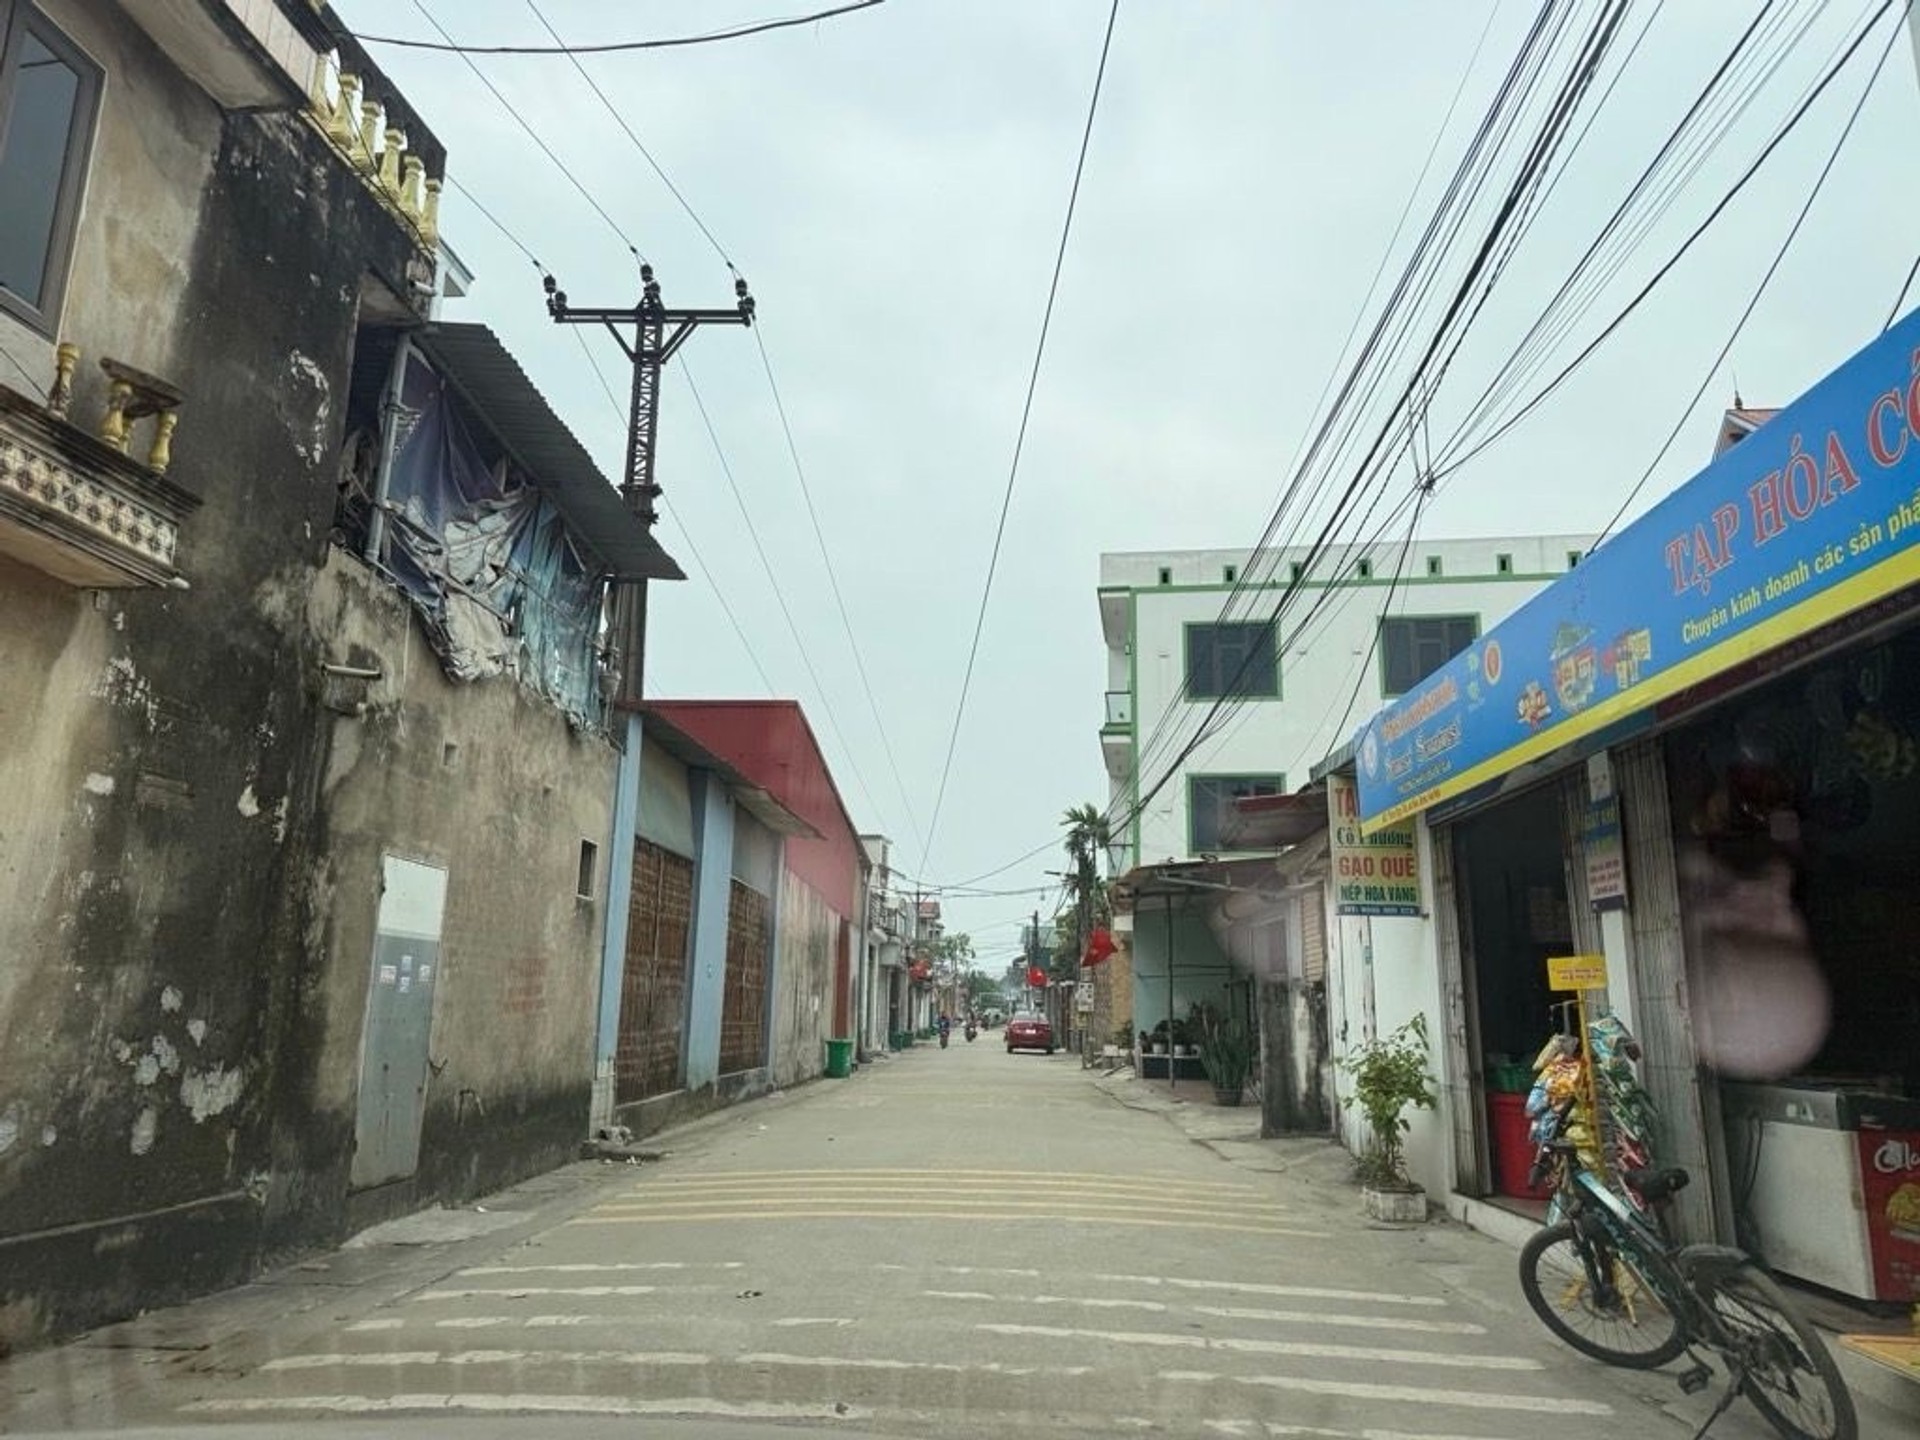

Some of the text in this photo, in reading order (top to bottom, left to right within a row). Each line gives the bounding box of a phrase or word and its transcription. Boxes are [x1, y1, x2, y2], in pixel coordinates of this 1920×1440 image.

[1665, 502, 1739, 596] TẠP
[1748, 430, 1862, 548] HÓA
[1682, 605, 1728, 644] Chuyên
[1731, 586, 1762, 619] kinh
[1765, 559, 1810, 601] doanh
[1814, 543, 1845, 575] các
[1339, 855, 1374, 881] GẠO
